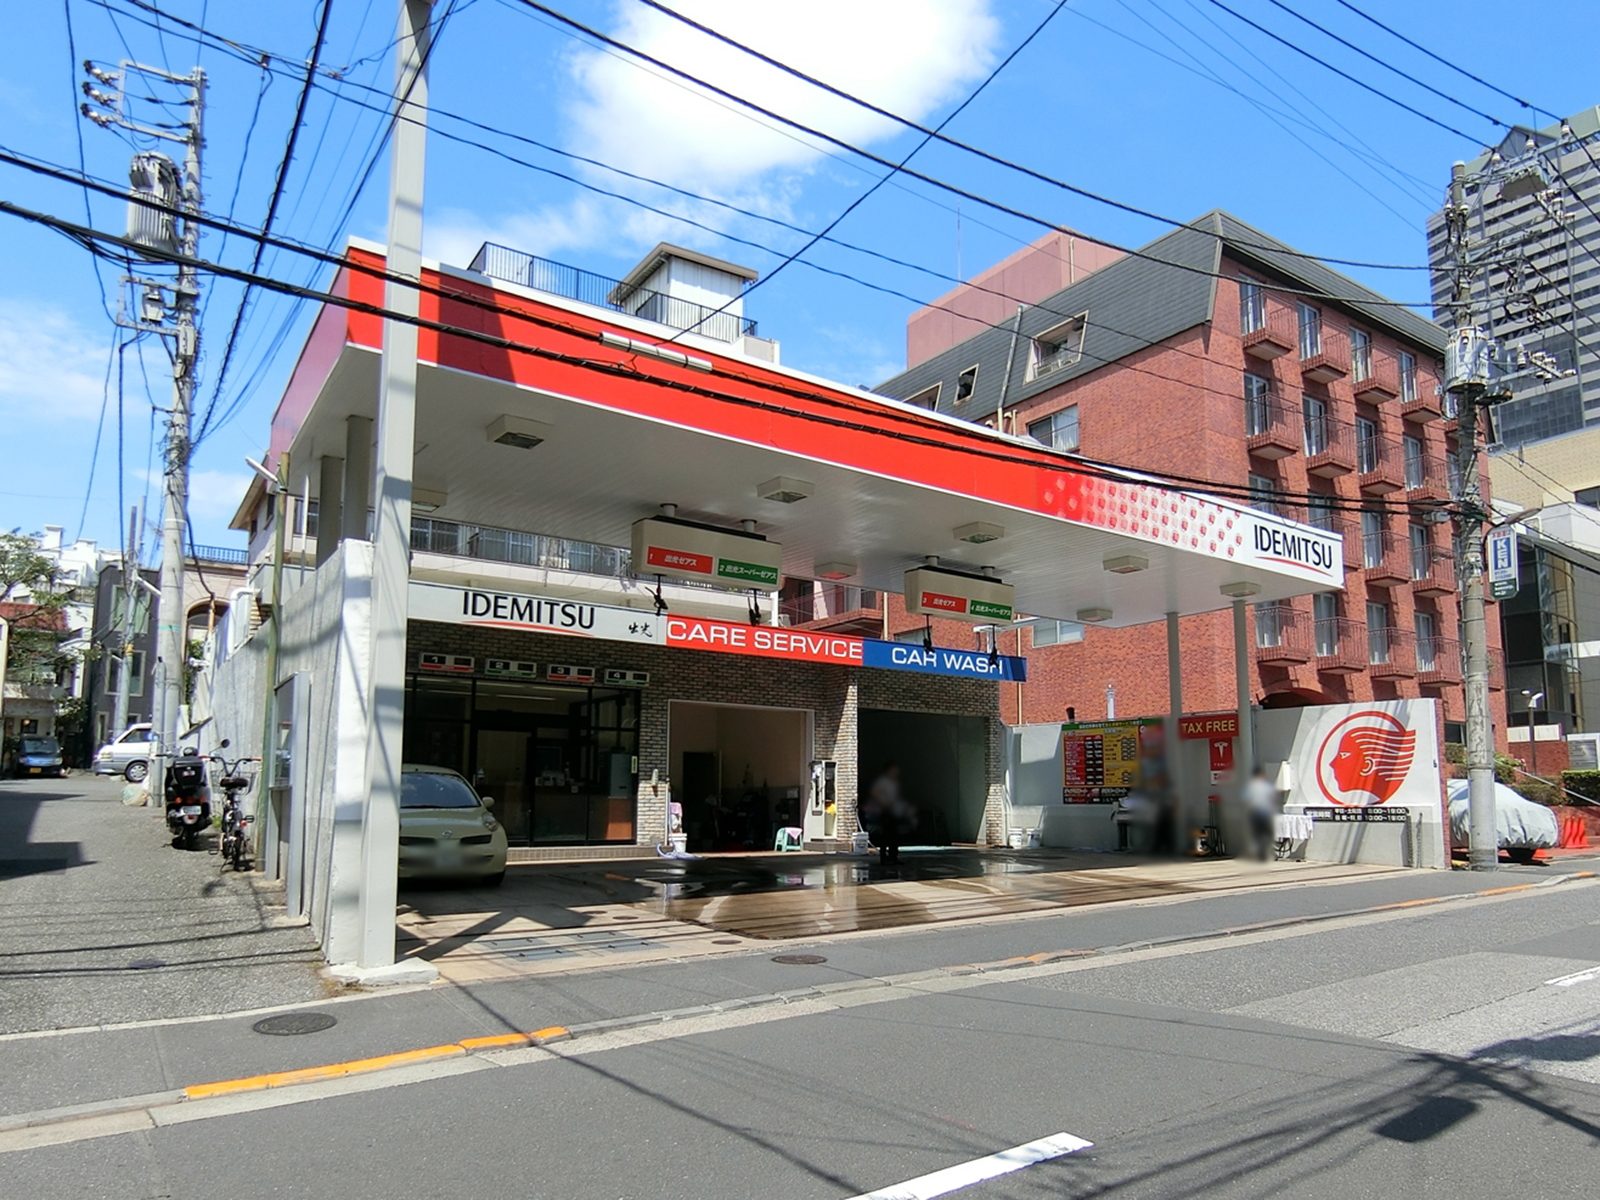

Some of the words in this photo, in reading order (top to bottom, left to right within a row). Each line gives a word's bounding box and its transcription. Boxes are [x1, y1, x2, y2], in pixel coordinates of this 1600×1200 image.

[1254, 524, 1333, 569] IDEMITSU
[1496, 539, 1509, 569] KEN
[463, 591, 595, 629] IDEMITSU
[667, 620, 747, 647] CARE
[754, 631, 863, 660] SERVICE
[495, 661, 503, 669] 2
[891, 647, 937, 668] CAR
[1181, 722, 1203, 734] TAX
[1206, 719, 1235, 732] FREE
